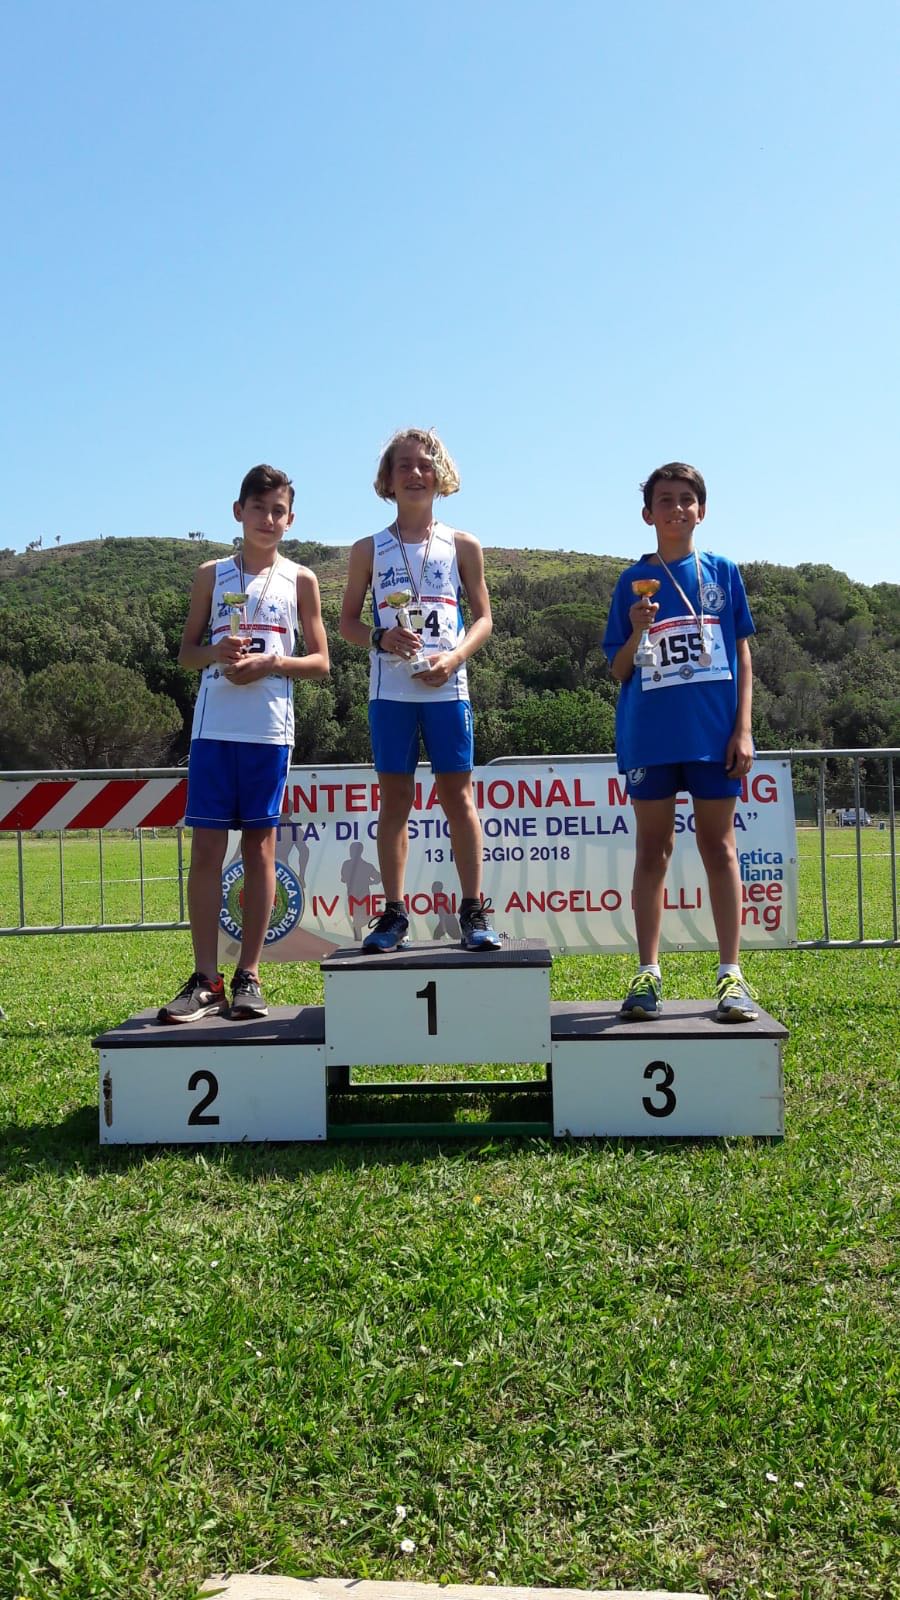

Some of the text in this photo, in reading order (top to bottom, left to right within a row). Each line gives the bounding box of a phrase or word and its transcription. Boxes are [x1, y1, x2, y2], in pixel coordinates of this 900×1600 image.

[336, 821, 359, 841] DI
[546, 815, 629, 836] DELLA
[425, 849, 444, 862] 13
[530, 846, 570, 860] 2018
[312, 895, 339, 916] IV
[505, 888, 622, 912] ANGELO
[416, 981, 438, 1036] 1
[188, 1070, 220, 1126] 2
[642, 1060, 677, 1118] 3
